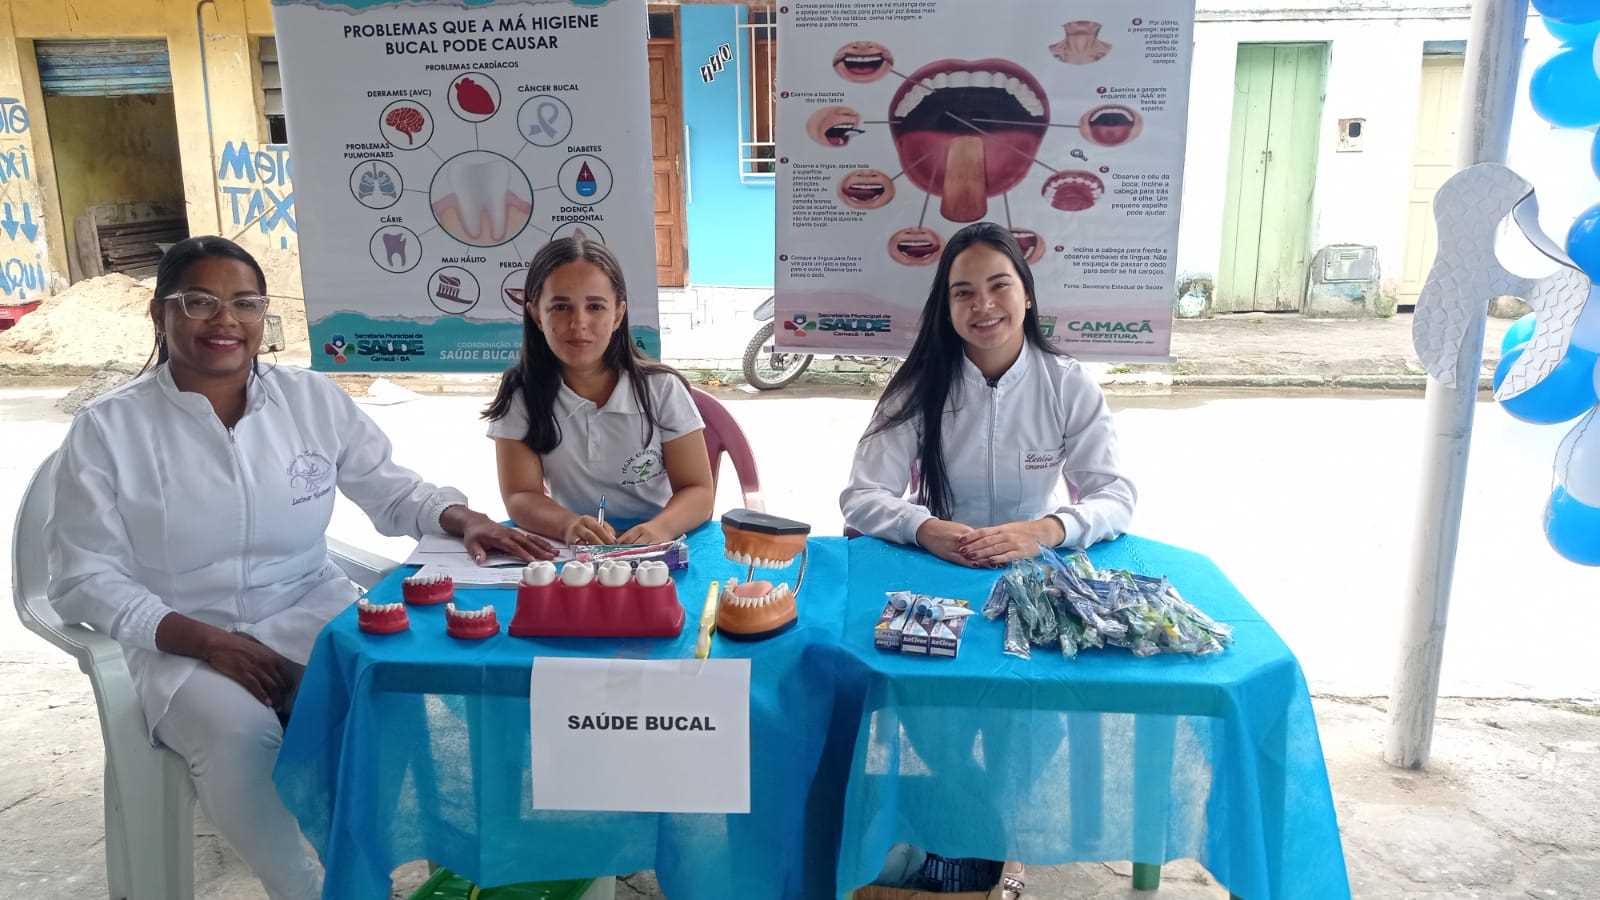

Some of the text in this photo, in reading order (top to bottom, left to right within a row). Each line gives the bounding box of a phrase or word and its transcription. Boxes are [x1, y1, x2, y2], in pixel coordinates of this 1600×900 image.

[344, 13, 599, 39] PROBLEMAS QUE A MÁ HIGIENE
[386, 36, 558, 55] BUCAL PODE CAUSAR
[425, 59, 519, 72] PROBLEMAS CARDÍACOS
[701, 44, 732, 83] 110
[367, 88, 432, 99] DERRAMES (AVC)
[518, 83, 579, 93] CÂNCER BUCAL
[346, 142, 390, 151] PROBLEMAS
[567, 144, 602, 153] DIABETES
[344, 151, 394, 160] PULMONARES
[560, 205, 594, 215] DOENÇA
[380, 214, 403, 224] CÁRIE
[552, 214, 604, 223] PERIODONTAL
[441, 254, 487, 265] MAU HÁLITO
[500, 261, 524, 270] PERDA
[1067, 320, 1153, 333] CAMACÃ
[440, 348, 479, 360] SAÚDE
[568, 712, 716, 731] SAÚDE BUCAL
